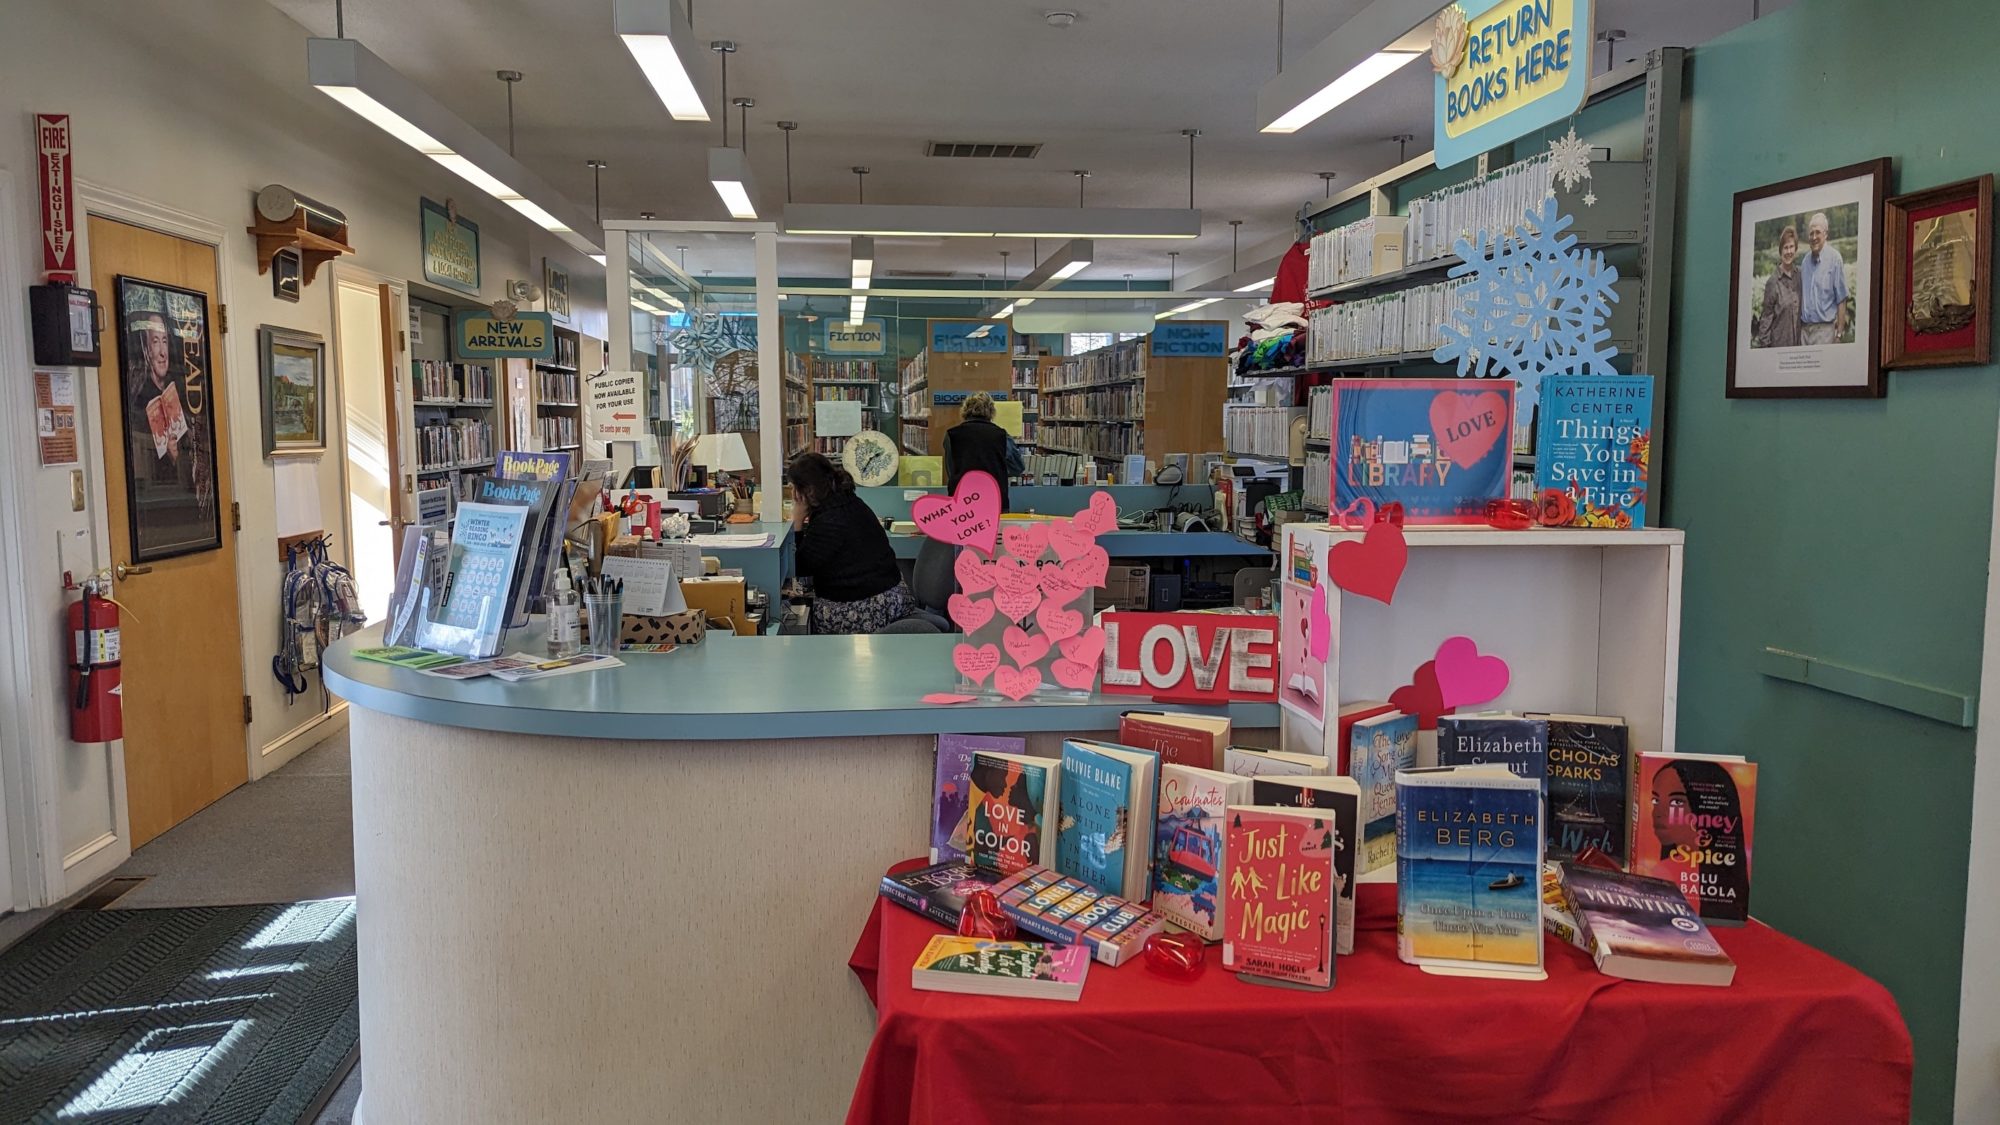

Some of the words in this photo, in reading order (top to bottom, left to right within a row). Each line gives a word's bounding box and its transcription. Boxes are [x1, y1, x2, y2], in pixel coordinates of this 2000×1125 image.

[1469, 0, 1552, 69] RETURN
[1447, 66, 1508, 123] BOOKS
[1515, 29, 1570, 90] HERE
[42, 127, 66, 149] FIRE
[51, 153, 64, 252] EXTINGUISHER
[487, 322, 524, 334] NEW
[829, 331, 881, 342] FICTION
[1168, 328, 1210, 339] NON-
[468, 335, 542, 348] ARRIVALS
[934, 334, 1006, 346] FICTION
[1153, 342, 1223, 353] FICTION
[178, 309, 203, 415] READ
[594, 380, 614, 389] PUBLIC
[615, 377, 634, 386] COPIER
[607, 387, 636, 398] AVAILABLE
[1555, 387, 1646, 398] KATHERINE
[933, 394, 1008, 402] BIOGRIES
[1571, 403, 1633, 414] CENTER
[605, 425, 615, 433] cents
[622, 426, 631, 436] copy
[1446, 410, 1496, 443] LOVE
[1556, 418, 1642, 445] Things
[1581, 443, 1626, 463] You
[503, 456, 560, 478] BookPage
[1348, 461, 1451, 487] LIBRARY
[1551, 462, 1606, 482] Save
[1613, 463, 1636, 483] in
[482, 481, 541, 505] BookPage
[1565, 487, 1577, 500] a
[1583, 487, 1632, 507] Fire
[920, 503, 953, 524] WHAT
[963, 492, 980, 505] DO
[951, 510, 974, 526] YOU
[467, 532, 487, 541] BINGO
[1103, 622, 1274, 693] LOVE
[1151, 738, 1178, 758] The
[1373, 733, 1390, 750] The
[1393, 730, 1411, 745] Love
[1457, 736, 1543, 753] Elizabeth
[1373, 750, 1396, 770] Song
[1398, 747, 1405, 759] of
[1471, 757, 1529, 774] Sut
[1549, 748, 1619, 767] CHOLAS
[1066, 756, 1092, 779] OLIVIE
[1094, 767, 1121, 790] BLAKE
[1547, 764, 1602, 781] SPARKS
[1166, 779, 1224, 813] Soulmates
[1295, 792, 1315, 806] the
[1374, 781, 1395, 797] Quee
[984, 801, 1026, 825] LOVE
[1070, 794, 1111, 820] ALONE
[1075, 814, 1103, 831] WITH
[1418, 810, 1534, 825] ELIZABETH
[1668, 807, 1738, 833] Honey
[998, 822, 1009, 834] IN
[1437, 828, 1515, 848] BERG
[1695, 829, 1713, 847] &
[975, 830, 1031, 858] COLOR
[1239, 824, 1289, 863] Just
[1561, 824, 1613, 853] Wish
[1069, 843, 1079, 855] IN
[1367, 842, 1390, 864] Rachel
[1669, 844, 1736, 868] Spice
[900, 866, 968, 887] ELECTRIC
[928, 870, 976, 887] IDOL
[1065, 858, 1106, 886] ETHER
[1277, 863, 1322, 900] Like
[1681, 872, 1718, 883] BOLU
[881, 884, 906, 899] ELECTRIC
[906, 896, 919, 906] IDOL
[1024, 880, 1044, 894] THE
[1028, 881, 1075, 910] LONELY
[1681, 884, 1736, 898] BALOLA
[1050, 890, 1098, 919] HEARTS
[1584, 888, 1690, 916] VALENTINE
[929, 908, 945, 919] KATEE
[1075, 900, 1116, 925] BOOK
[1102, 910, 1135, 932] CLUB
[1241, 901, 1310, 944] Magic
[1420, 903, 1450, 914] Once
[1454, 905, 1482, 919] Upon
[1498, 908, 1531, 922] Time,
[1003, 909, 1020, 921] ONELY
[1021, 915, 1041, 929] HEARTS
[1042, 925, 1058, 937] BOOK
[1058, 931, 1072, 943] CLUB
[1433, 921, 1468, 933] There
[1472, 923, 1494, 935] Was
[1498, 924, 1519, 936] You
[1246, 958, 1275, 969] SARAH
[1279, 963, 1307, 974] HOGLE
